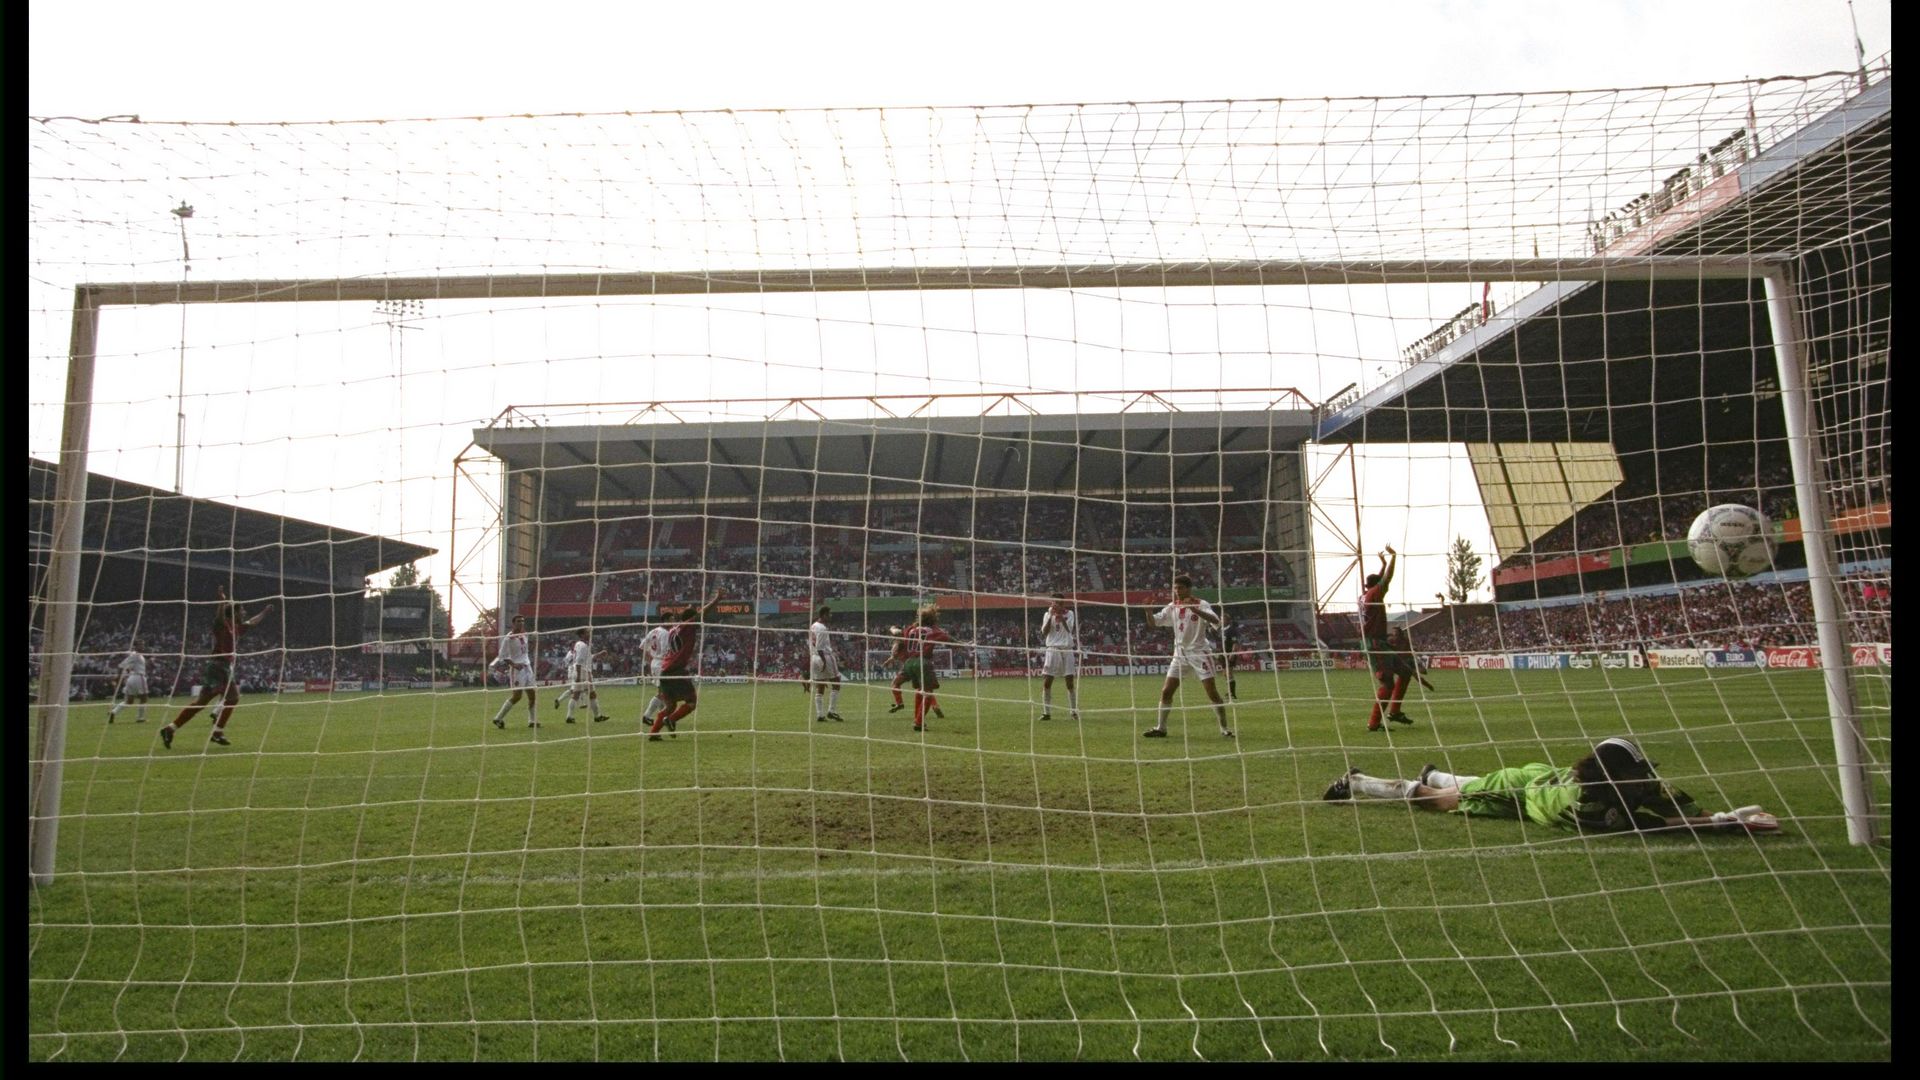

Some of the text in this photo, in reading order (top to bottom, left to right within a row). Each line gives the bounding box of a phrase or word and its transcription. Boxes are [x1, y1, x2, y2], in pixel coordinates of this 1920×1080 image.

[717, 605, 742, 613] TURKEY
[1477, 657, 1505, 668] Canon
[1527, 655, 1561, 669] PHILIPS
[1660, 655, 1704, 666] MasterCard
[1726, 653, 1745, 662] EURO
[1769, 650, 1808, 668] Coca-Cola
[1292, 659, 1334, 669] EUROCARD
[975, 669, 992, 678] JVC
[1117, 665, 1171, 675] UMBR
